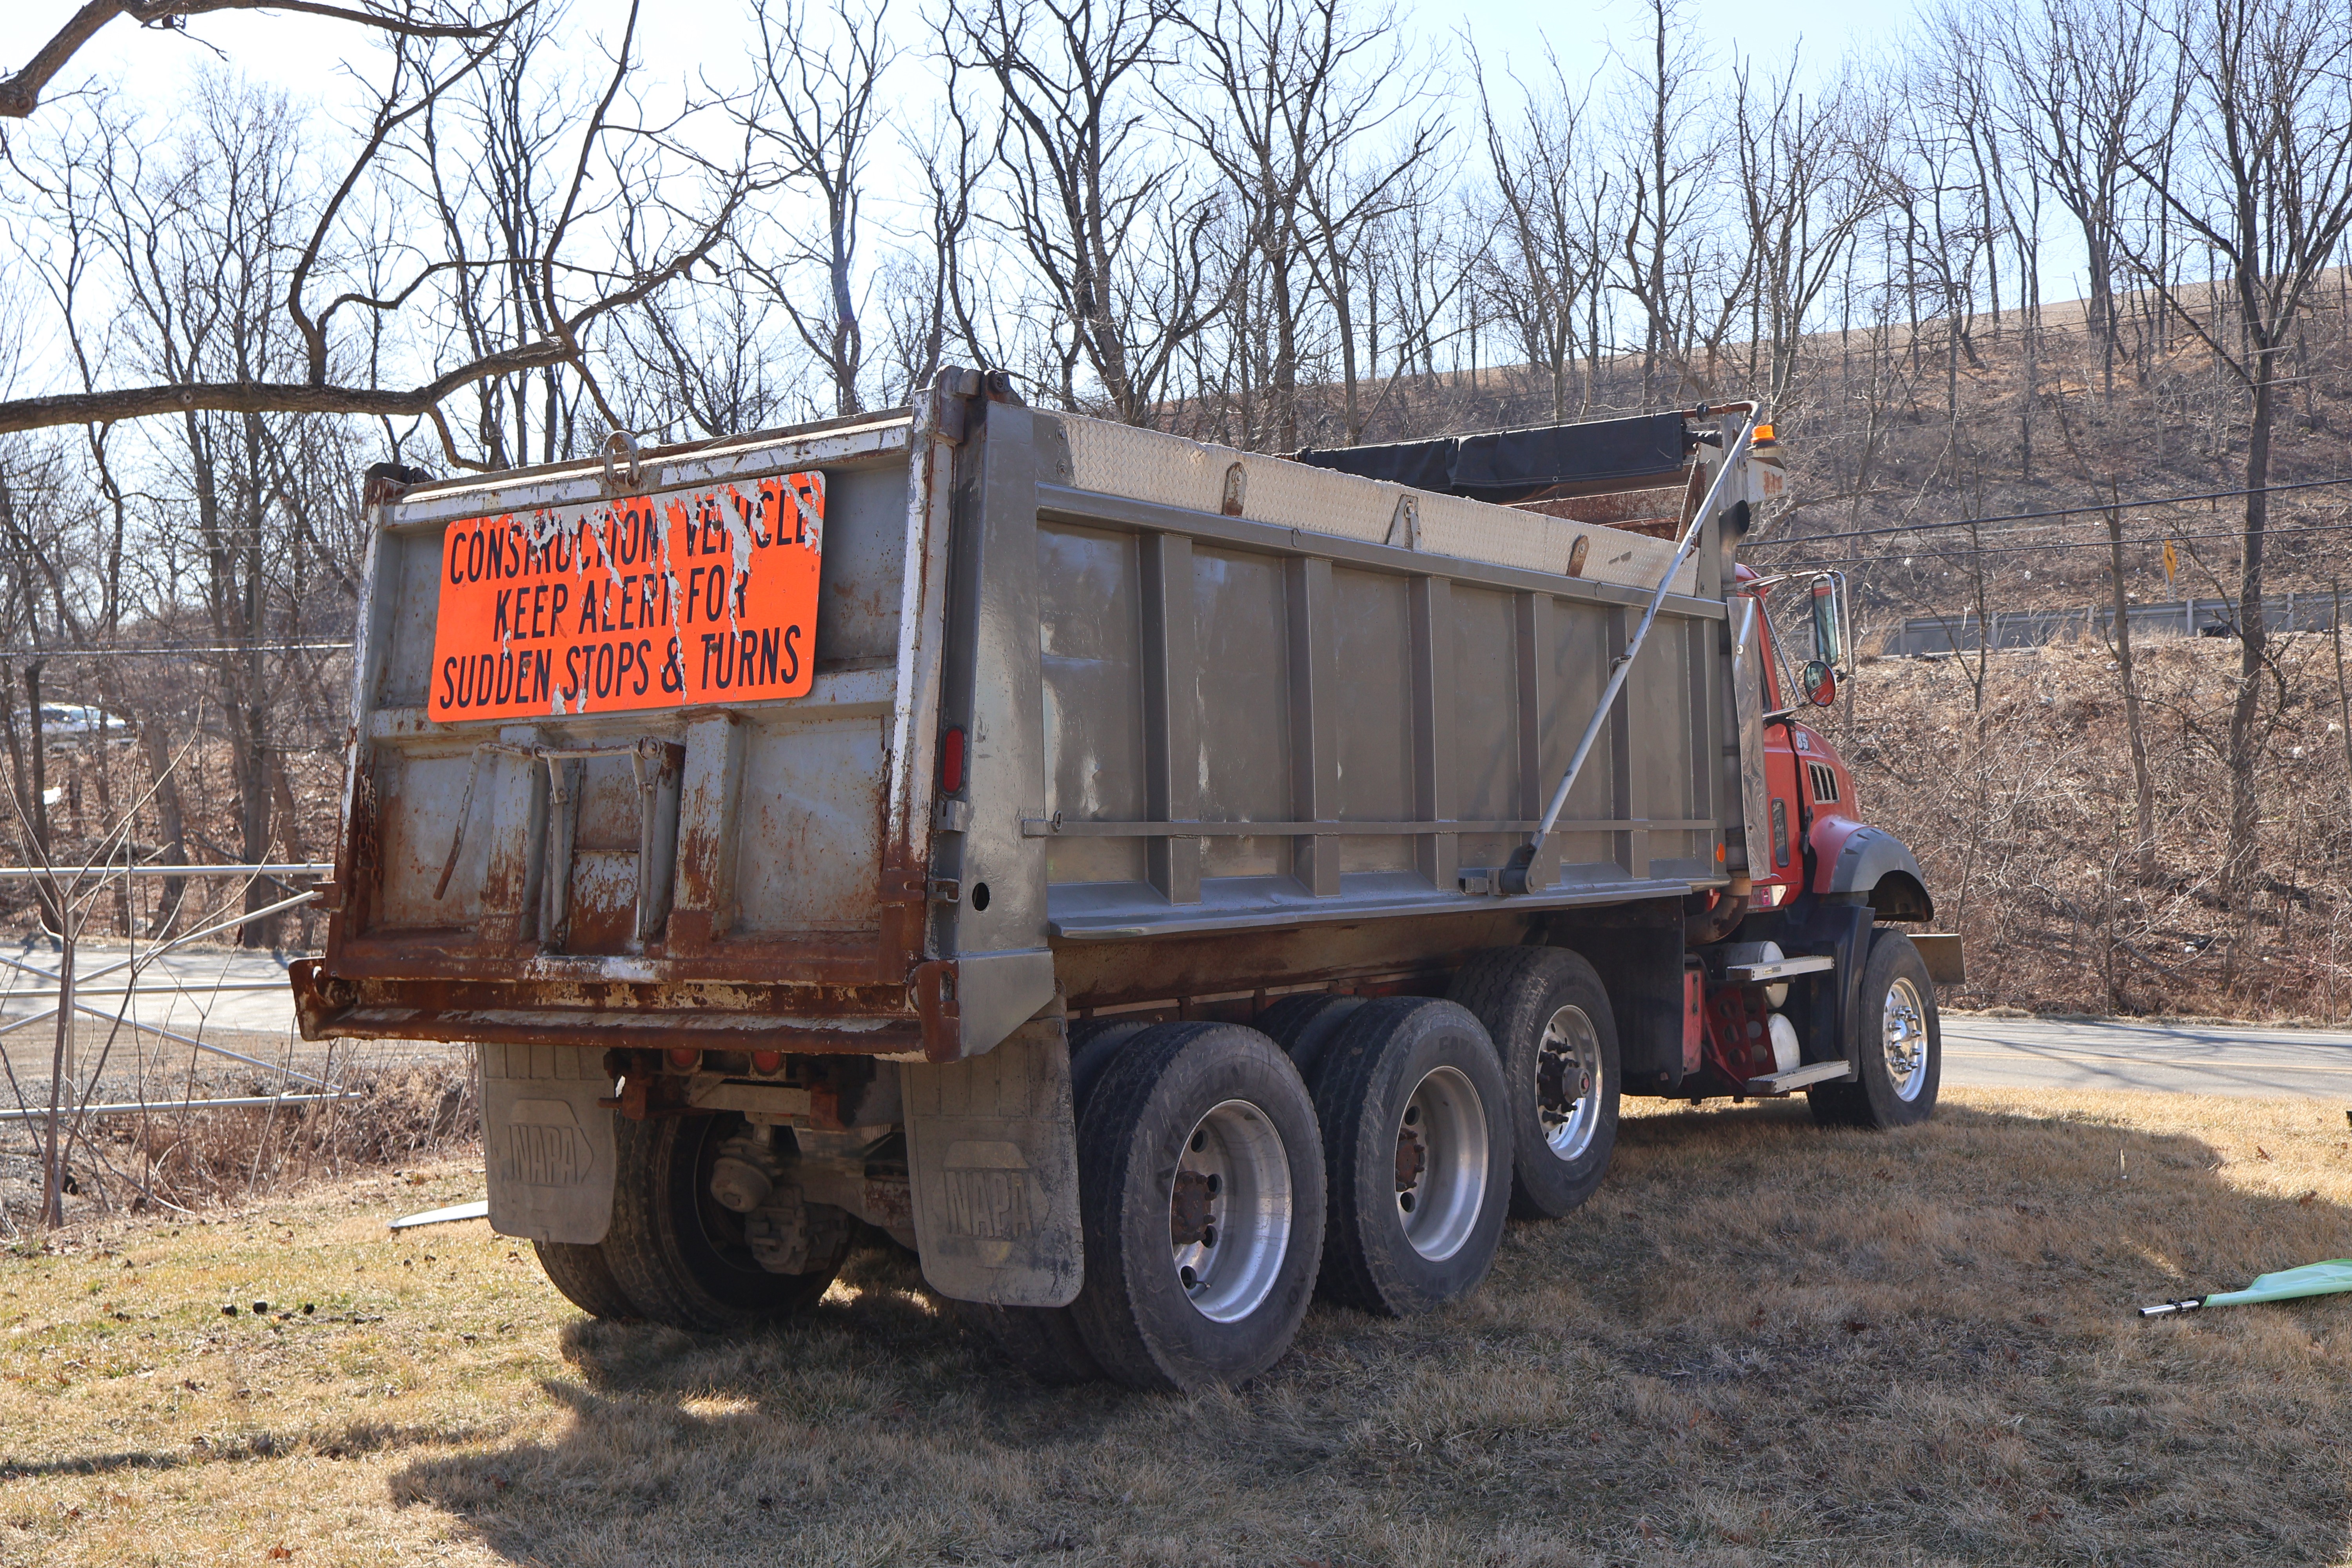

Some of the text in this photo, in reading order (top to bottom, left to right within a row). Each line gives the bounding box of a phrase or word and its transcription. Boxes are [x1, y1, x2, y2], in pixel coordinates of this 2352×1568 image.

[494, 564, 748, 641] KEEP ALERT FOR
[440, 625, 800, 709] SUDDEN STOPS & TURNS
[1795, 730, 1810, 752] 85
[510, 1124, 577, 1185] NAPA
[944, 1170, 1035, 1238] NAPA
